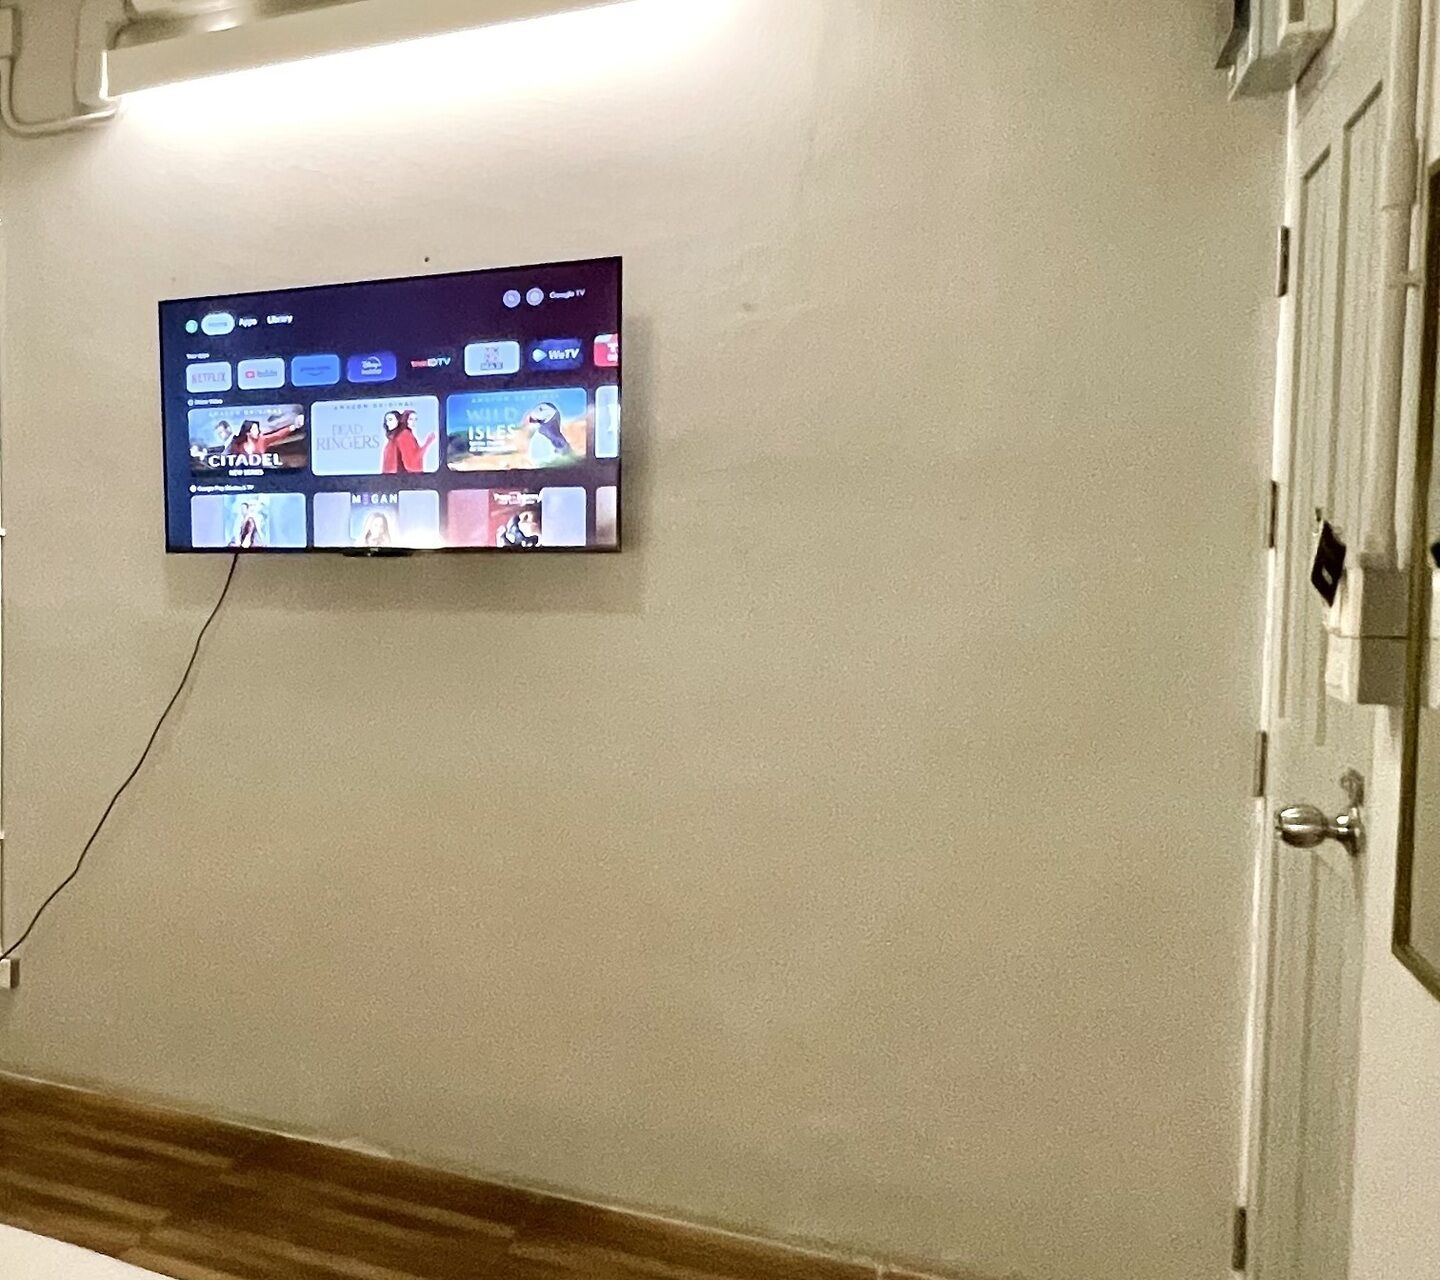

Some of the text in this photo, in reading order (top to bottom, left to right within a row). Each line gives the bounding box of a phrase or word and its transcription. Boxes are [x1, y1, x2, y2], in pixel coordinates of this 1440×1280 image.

[576, 289, 586, 297] TV
[239, 317, 258, 328] Apps
[266, 315, 293, 325] Library
[191, 372, 226, 384] NETFLIX
[466, 407, 517, 421] WILD
[332, 424, 363, 436] DEAD
[468, 423, 517, 440] ISLES
[316, 435, 380, 451] RINGERS
[208, 453, 283, 467] CITADEL
